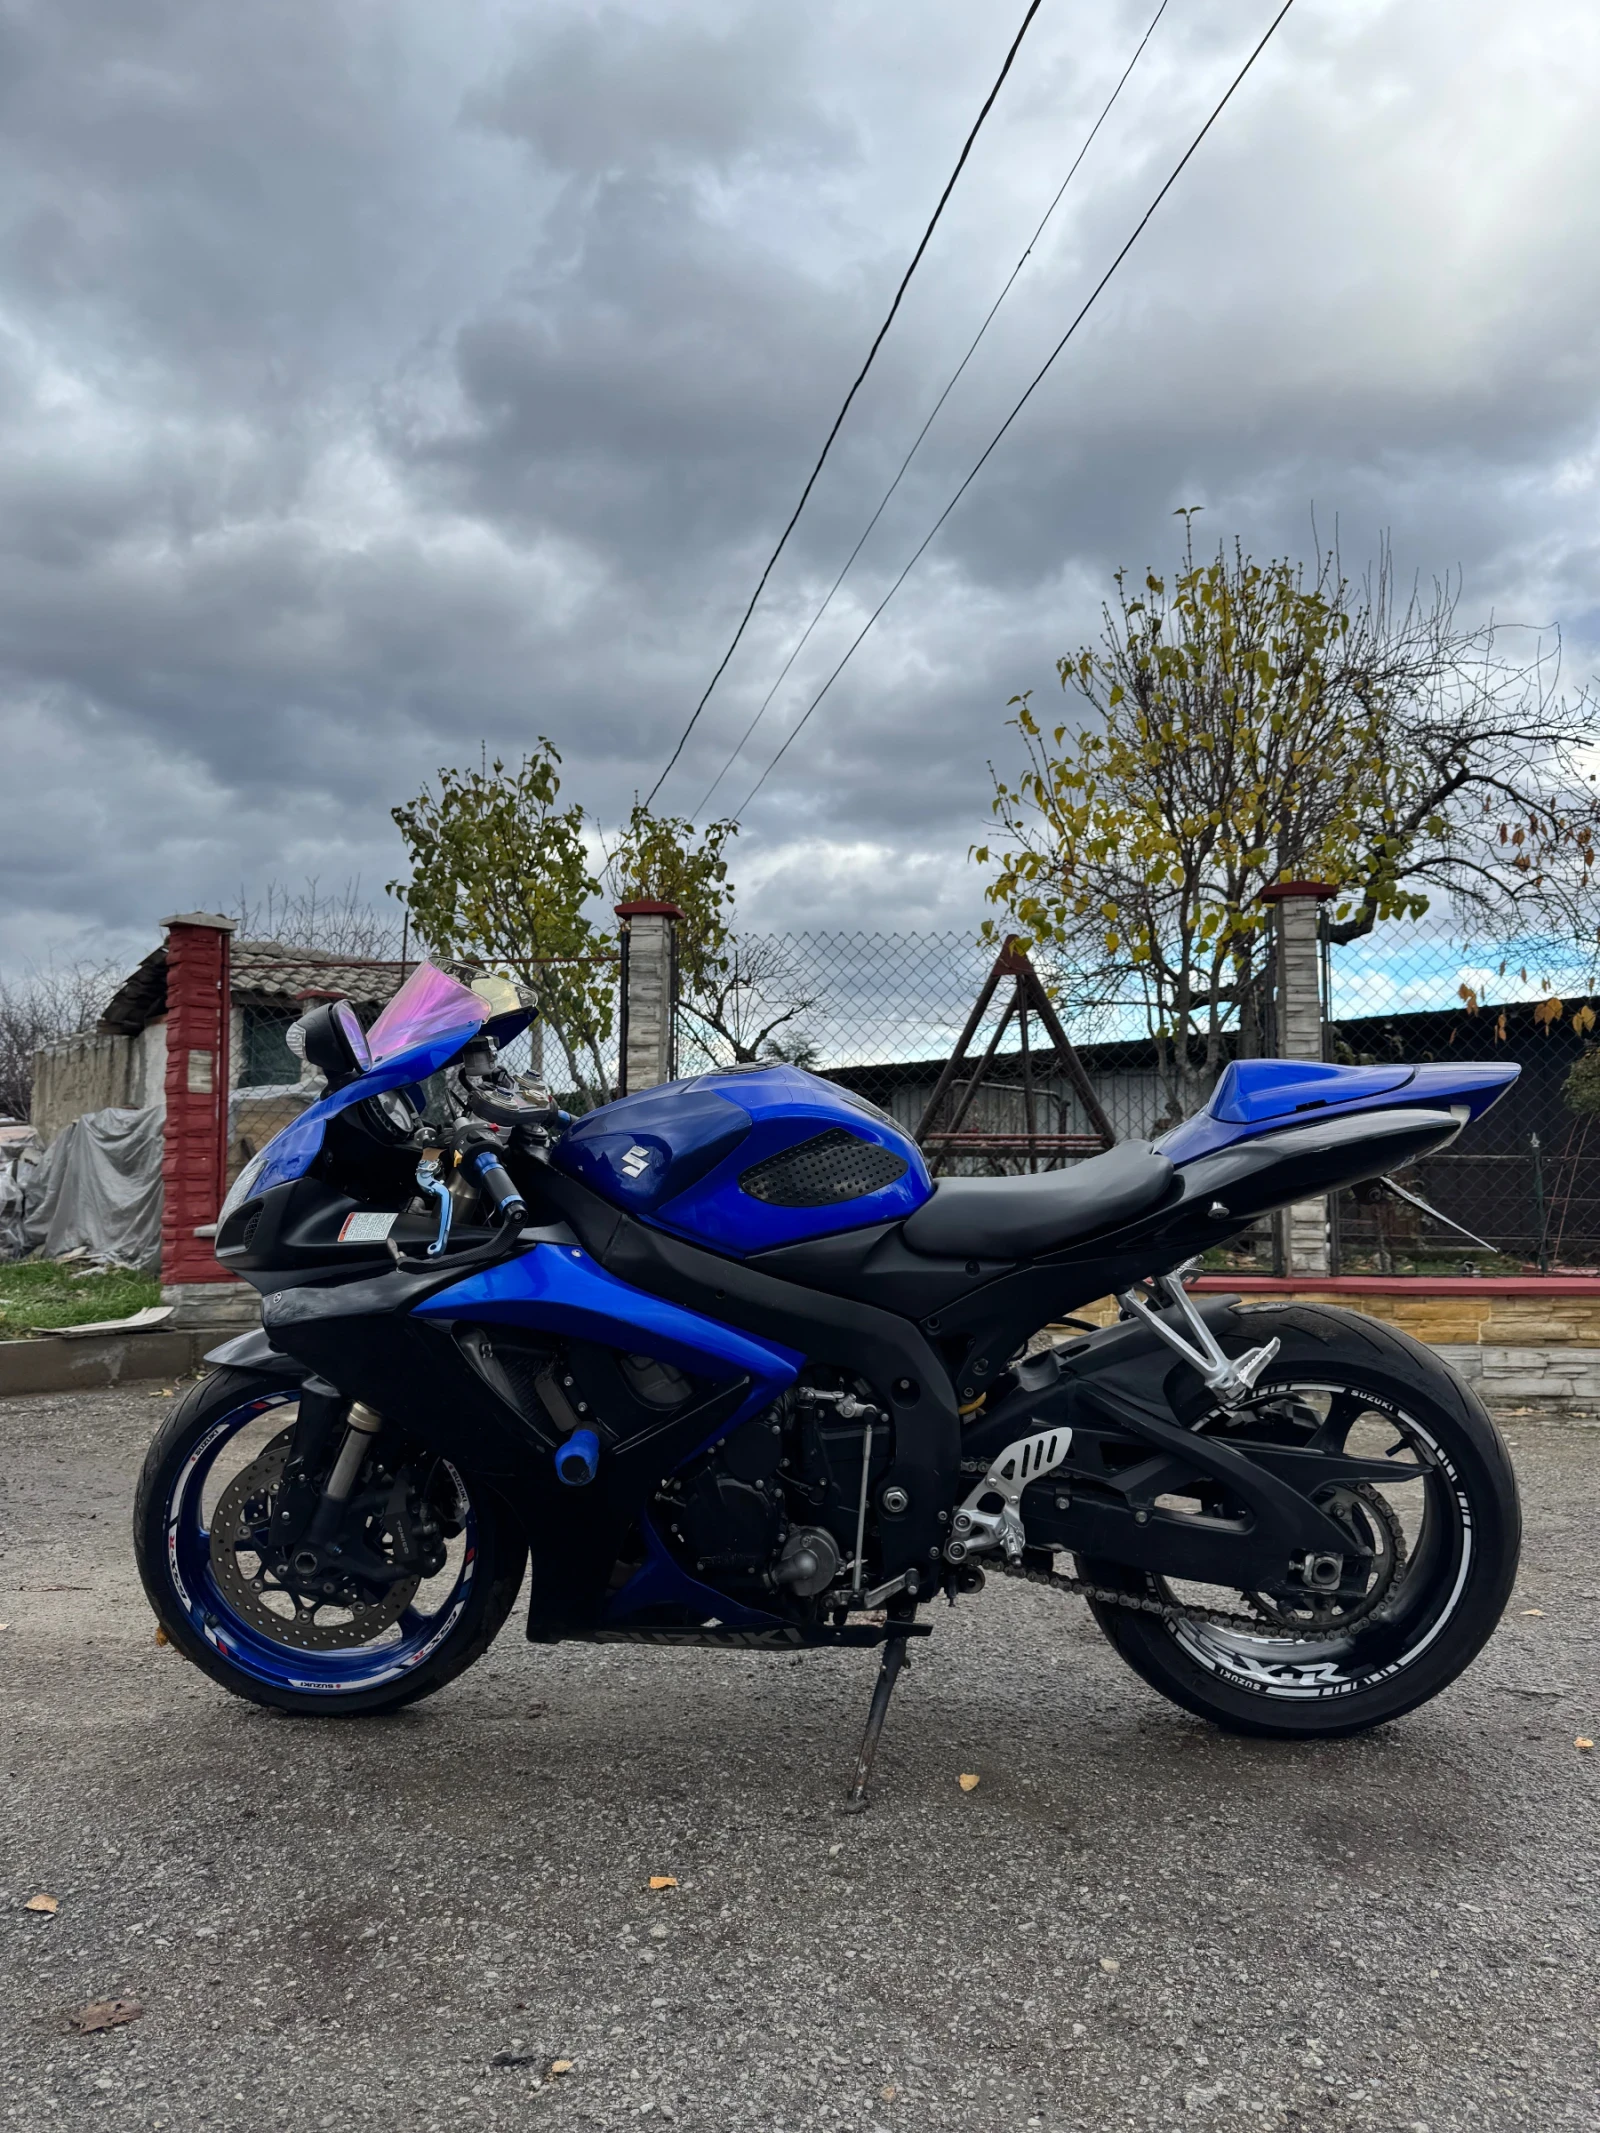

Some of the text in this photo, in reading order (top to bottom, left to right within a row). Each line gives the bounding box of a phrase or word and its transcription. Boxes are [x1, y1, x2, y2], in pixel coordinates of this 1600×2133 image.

[1351, 1389, 1394, 1411] SUZUKI
[194, 1430, 219, 1457] SUZUKI
[452, 1470, 468, 1502] SUZUKI
[169, 1535, 188, 1600] GSX-R
[412, 1610, 457, 1662] GSX-R
[594, 1627, 805, 1646] SUZUKI
[1219, 1668, 1262, 1691] SUZUKI
